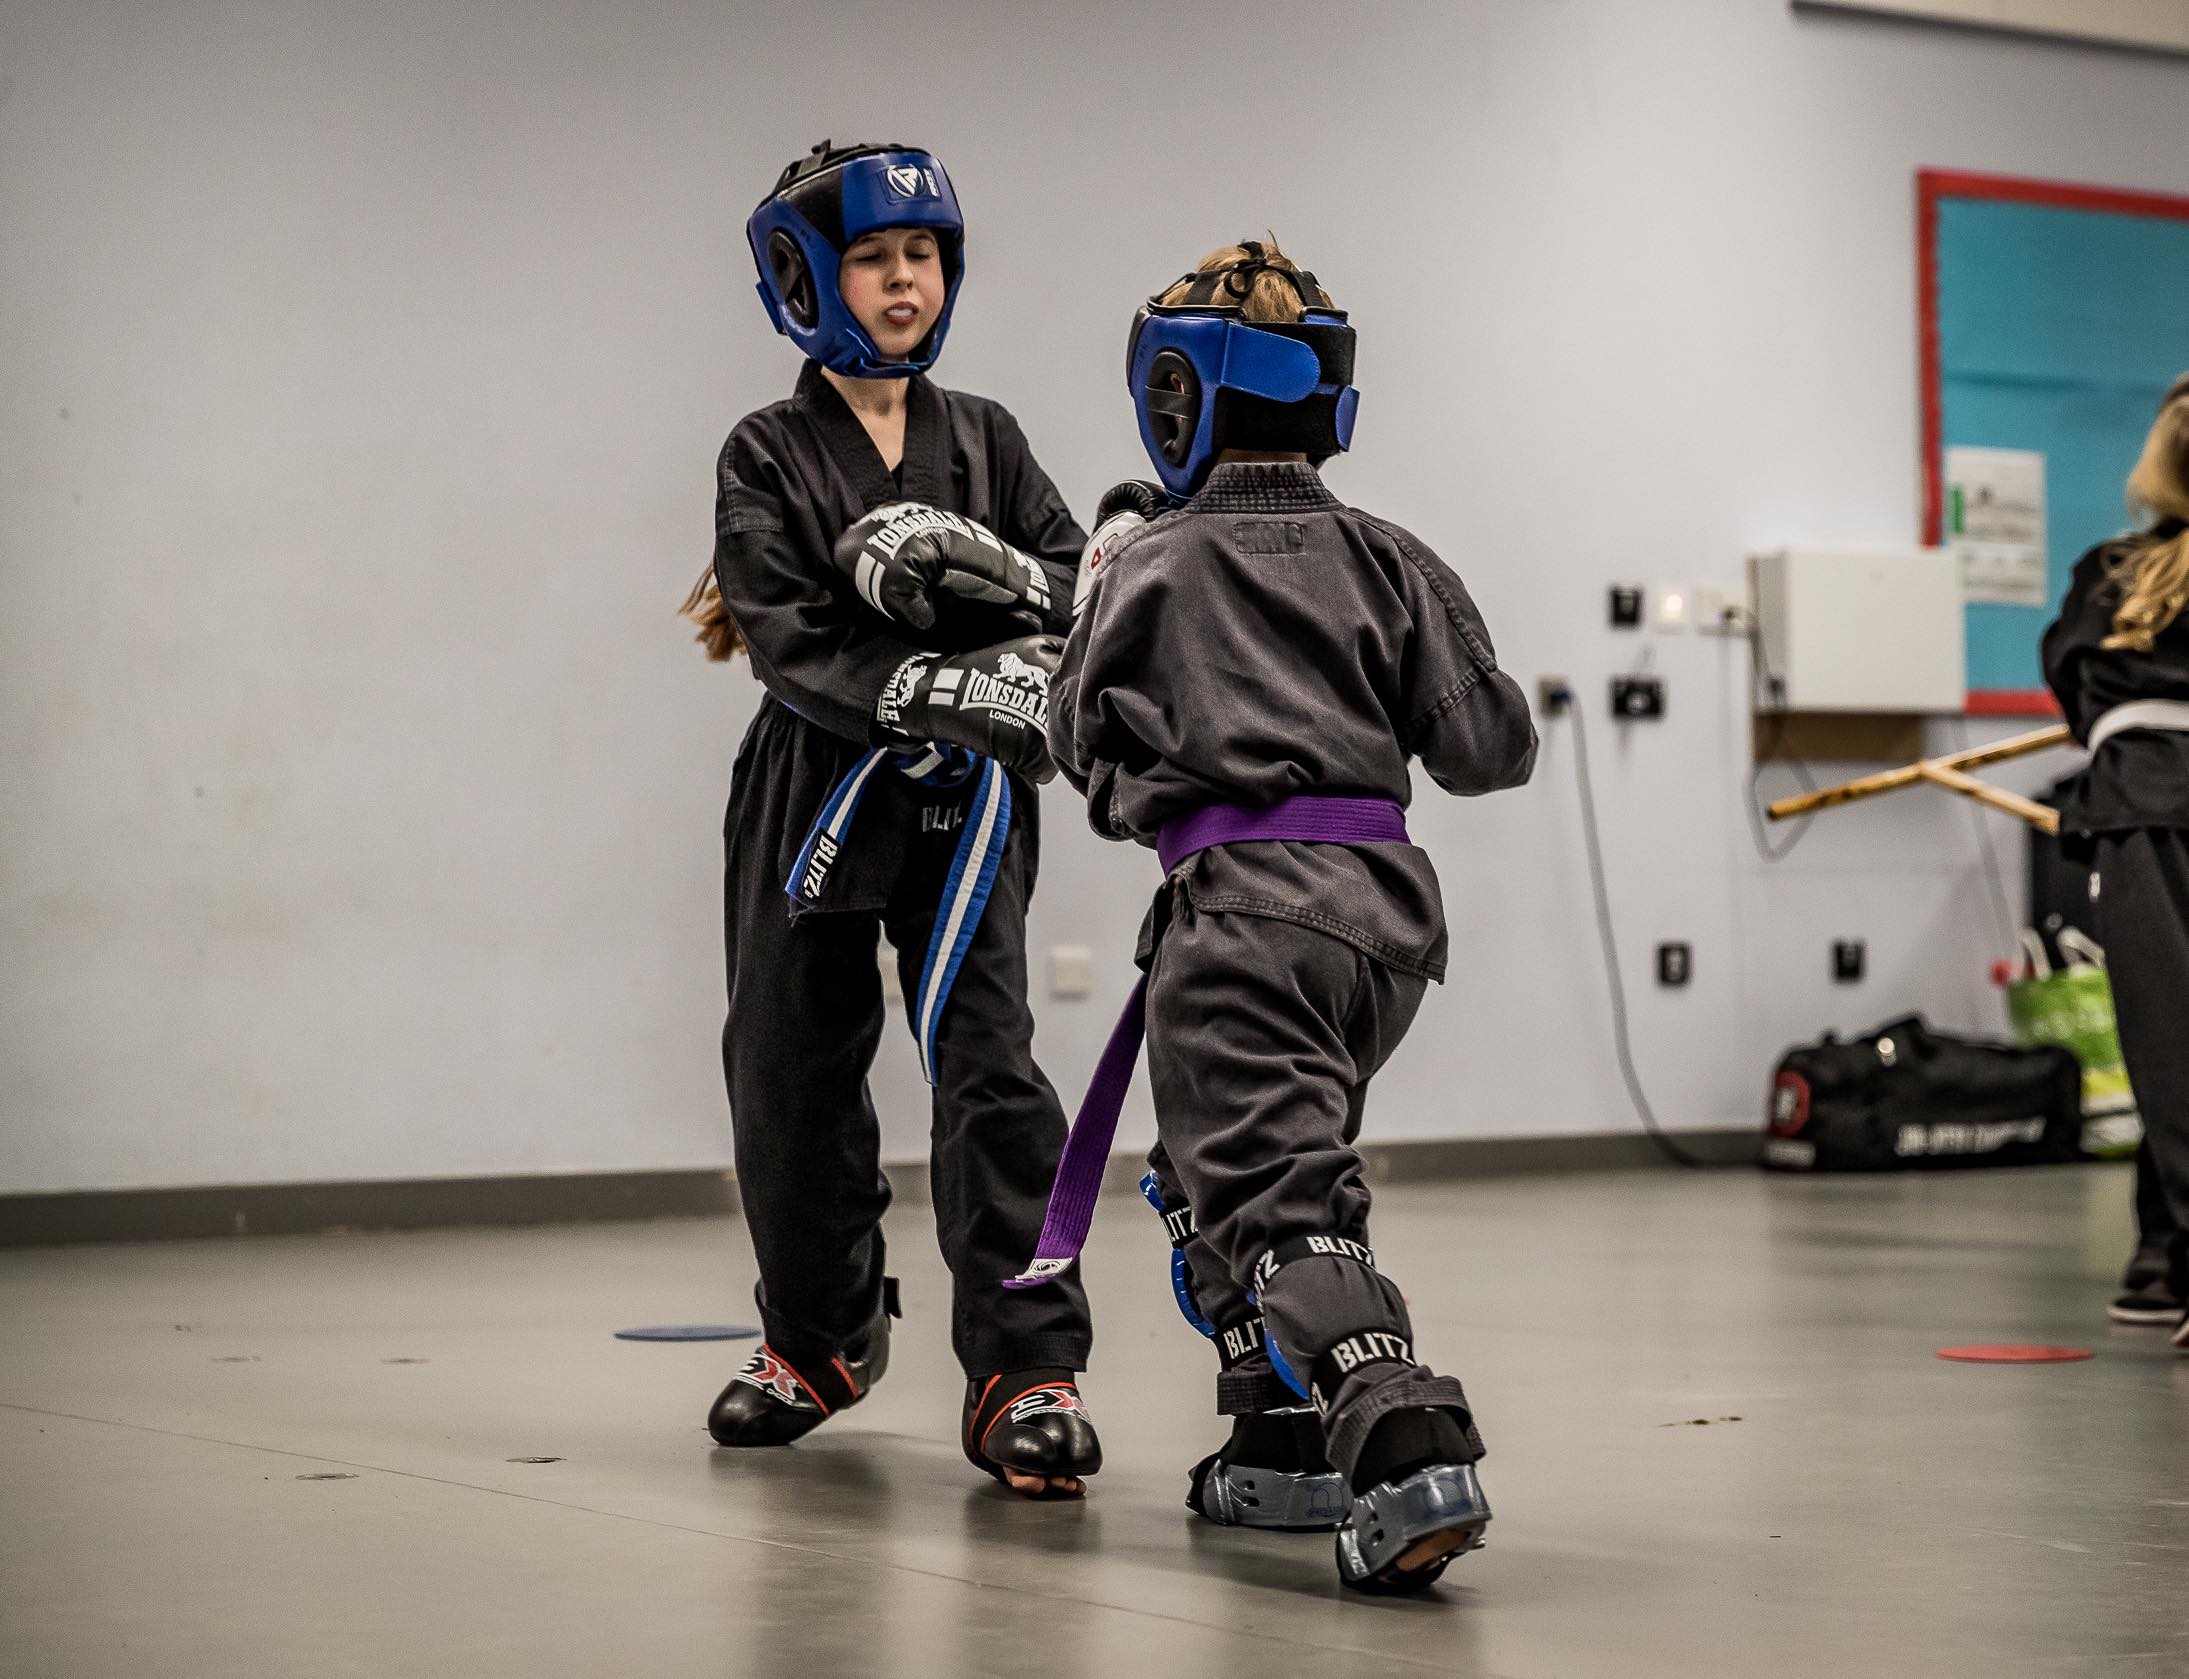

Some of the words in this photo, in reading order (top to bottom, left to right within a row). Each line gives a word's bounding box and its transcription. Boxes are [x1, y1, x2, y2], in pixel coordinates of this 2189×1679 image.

[959, 667, 1048, 738] LONSDAL
[989, 709, 1026, 730] LONDON
[803, 834, 838, 897] BLITZ
[1330, 1332, 1416, 1373] BLITZ
